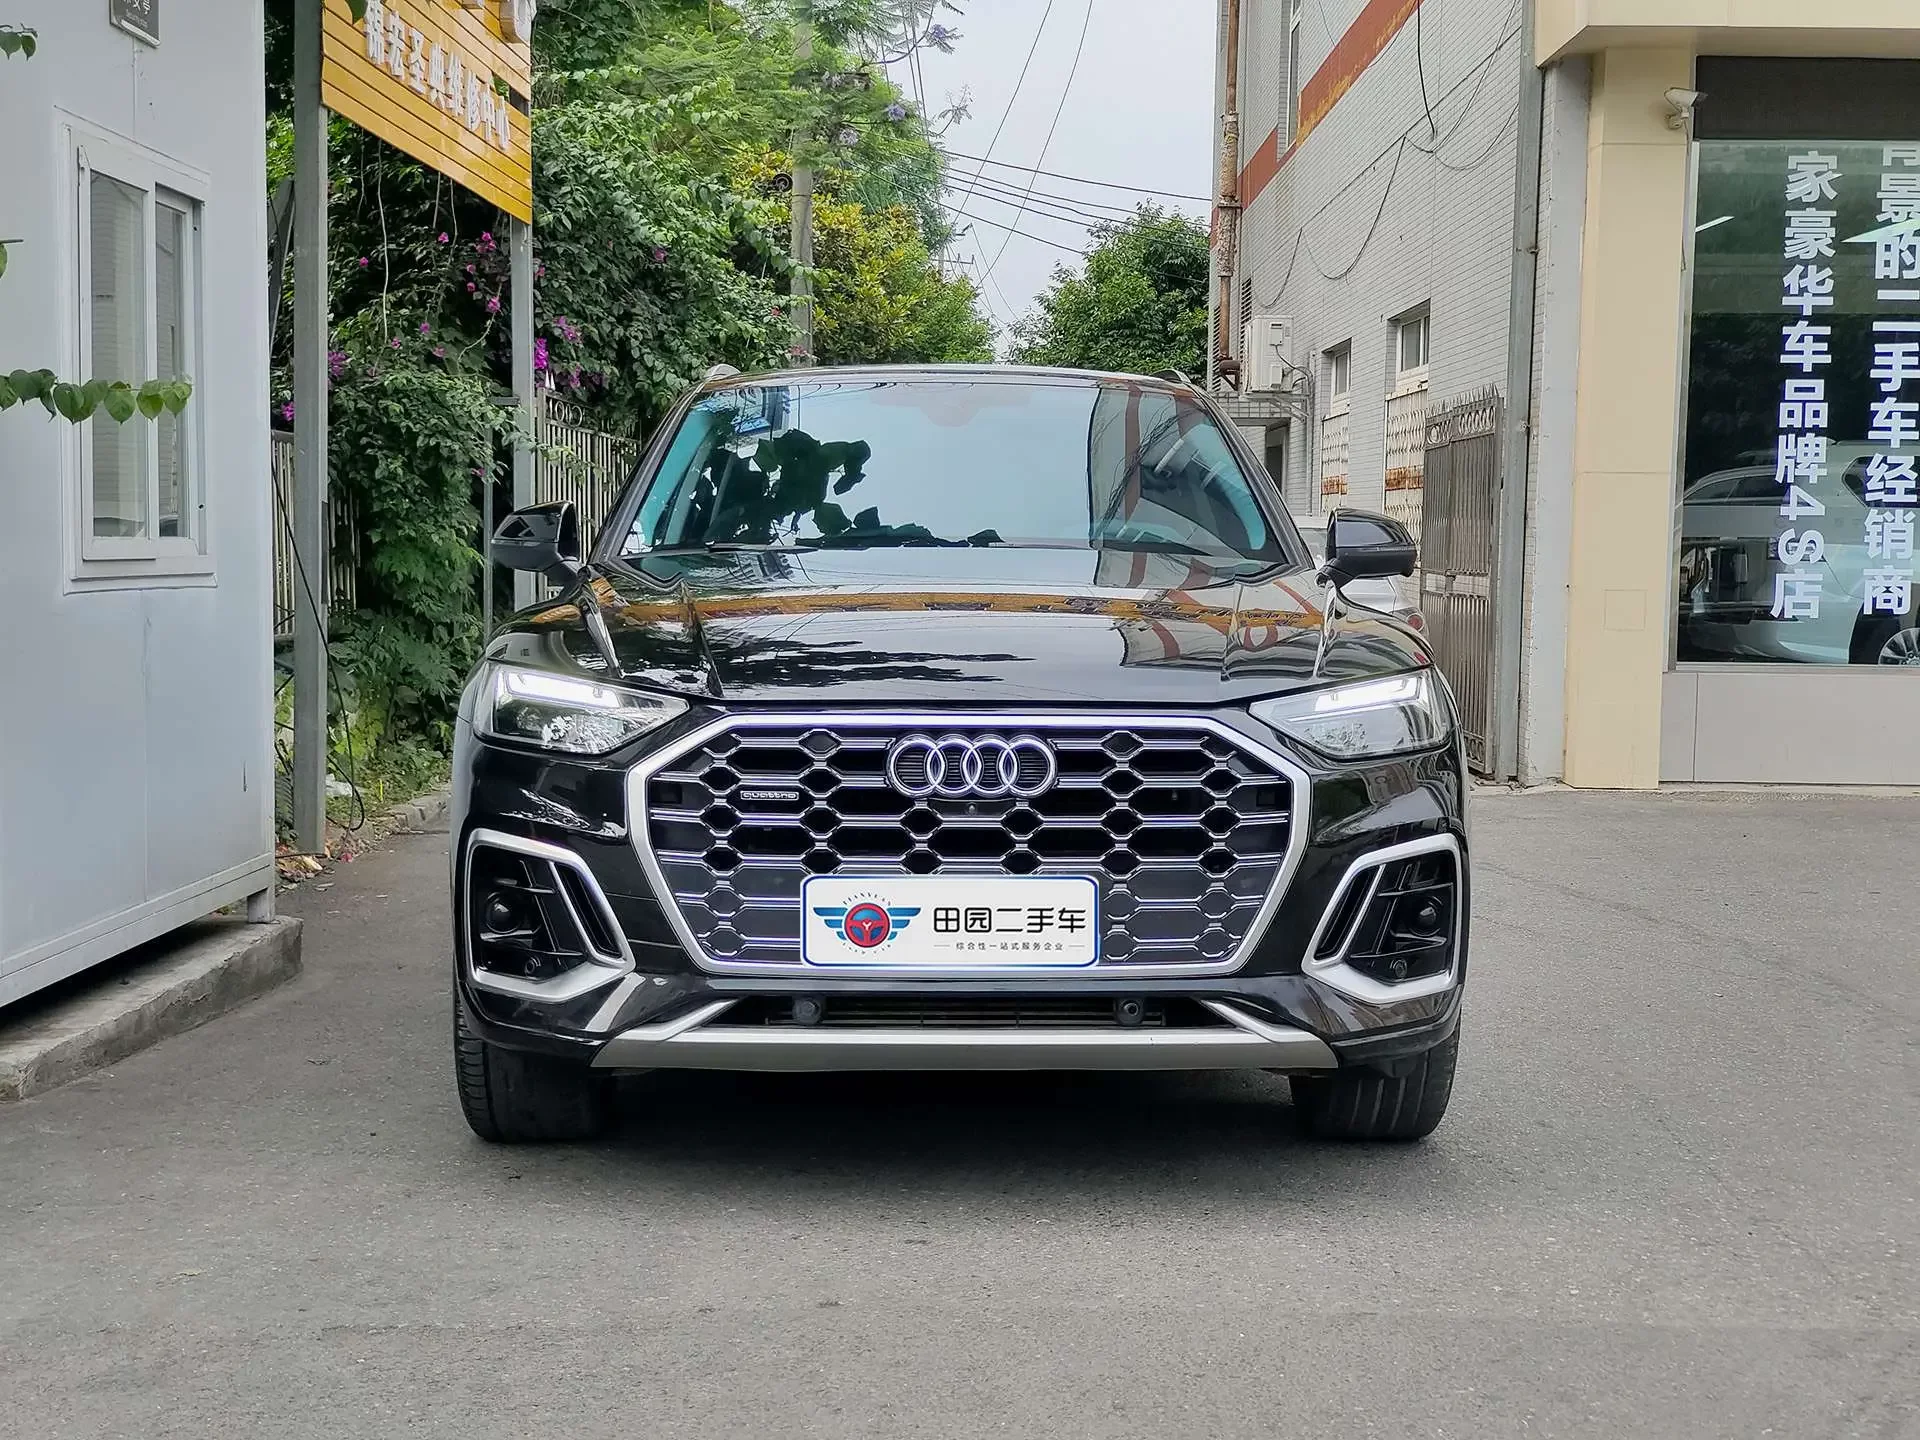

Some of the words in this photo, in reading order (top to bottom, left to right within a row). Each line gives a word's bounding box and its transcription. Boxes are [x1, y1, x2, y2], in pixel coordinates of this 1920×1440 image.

[1770, 151, 1838, 619] 家豪华车品牌4S店
[742, 791, 797, 799] quattro
[934, 907, 1087, 933] 田园二手车
[956, 941, 1063, 951] 综合性一站式服务企业
